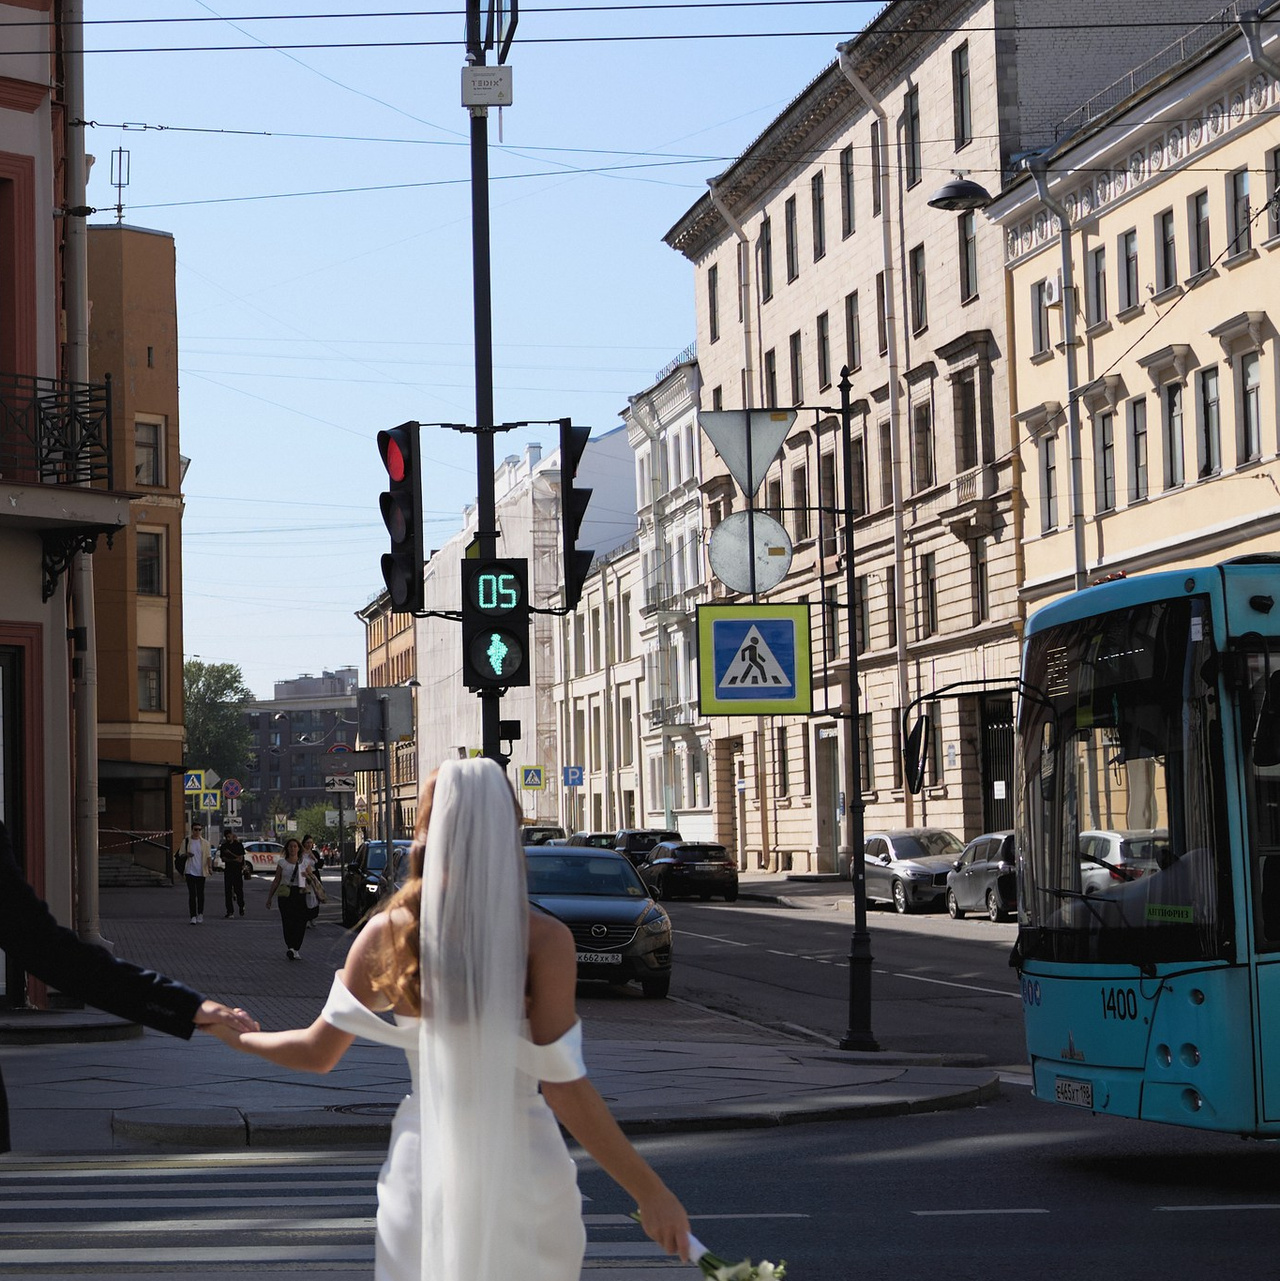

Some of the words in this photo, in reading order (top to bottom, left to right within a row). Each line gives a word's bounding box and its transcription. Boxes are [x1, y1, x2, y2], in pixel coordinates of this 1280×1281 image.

[479, 574, 517, 608] 05
[1147, 908, 1189, 919] АНТИФРИЗ
[1101, 986, 1137, 1020] 1400
